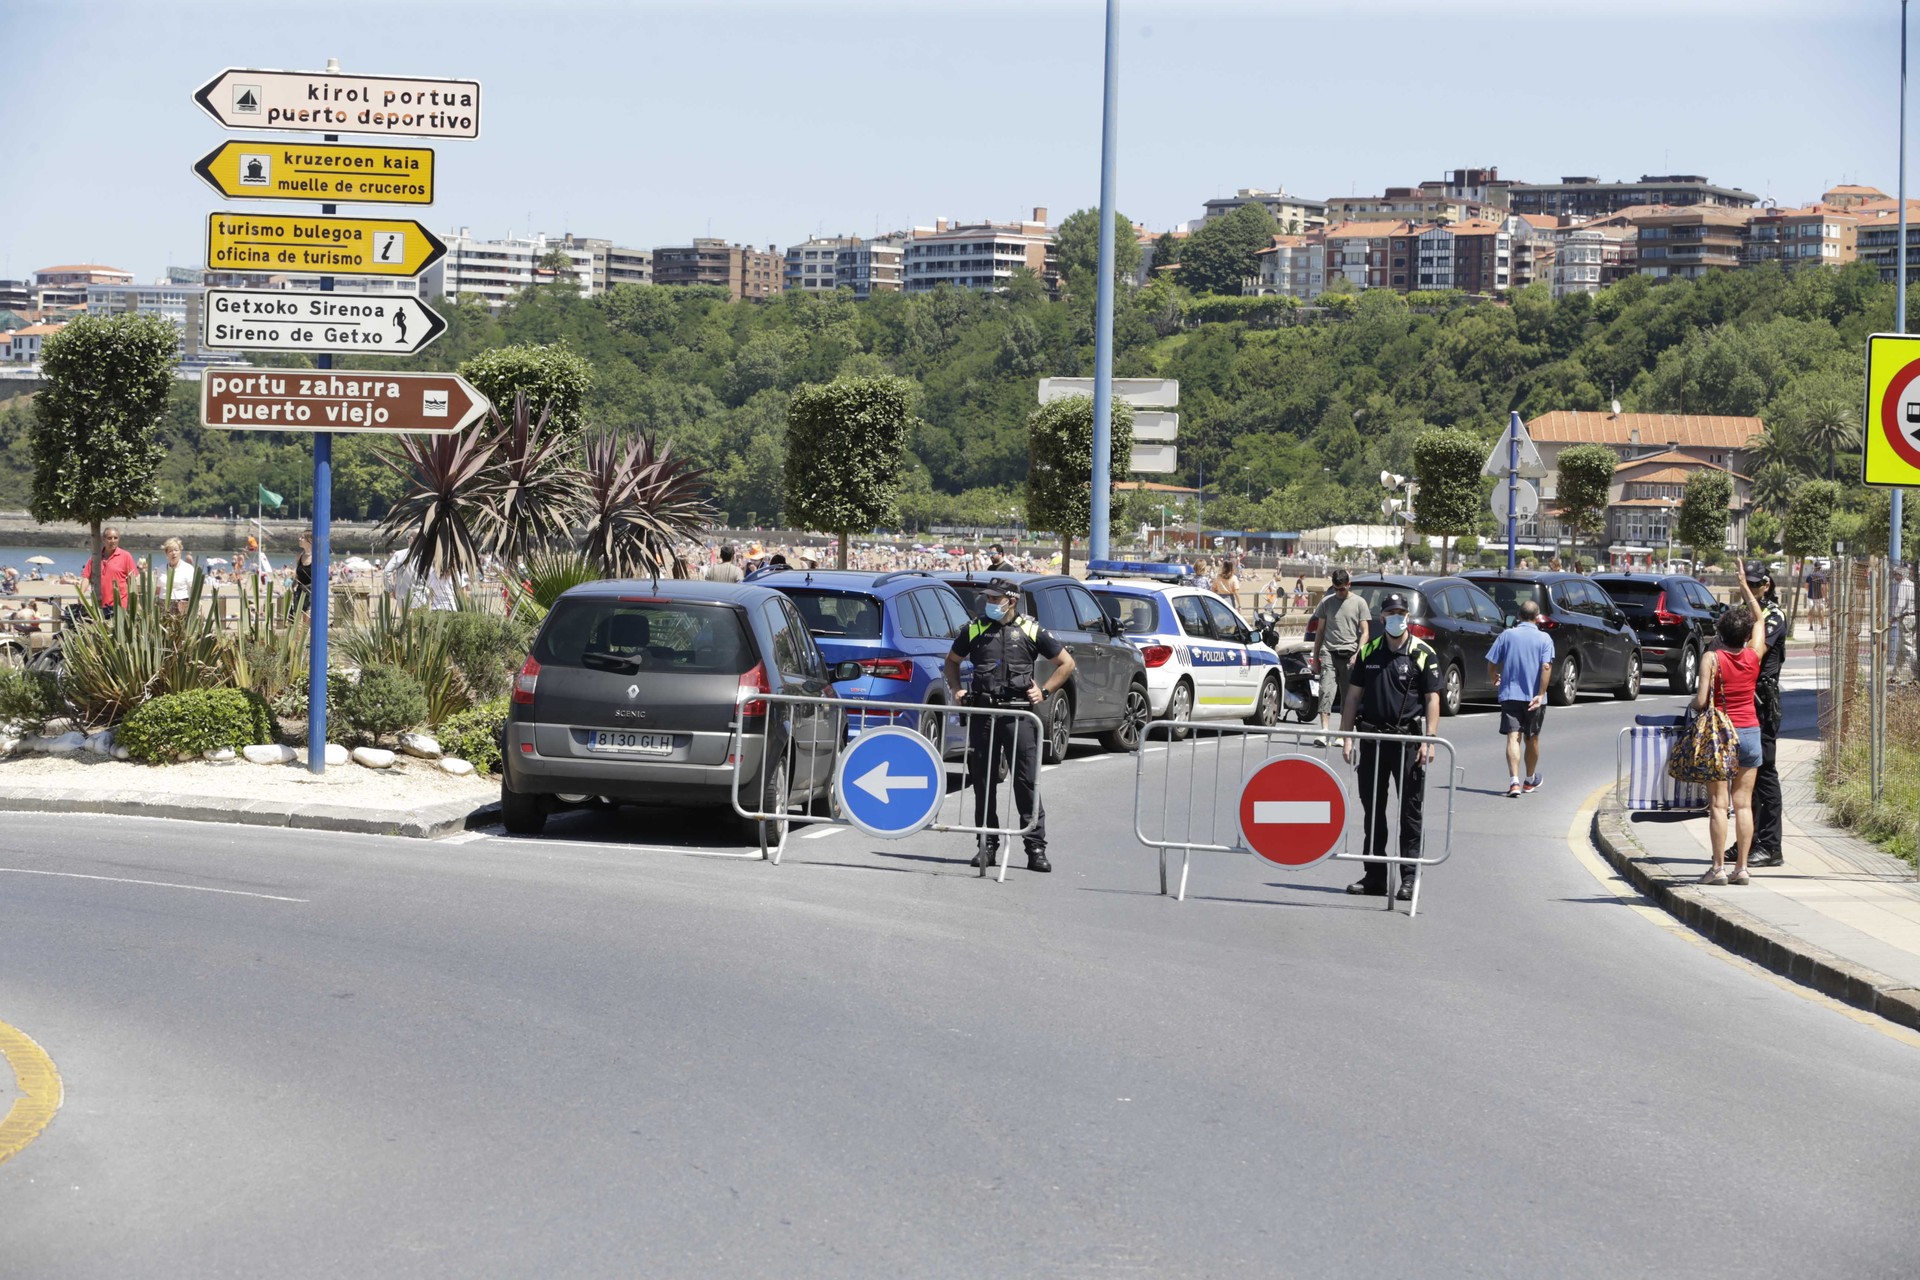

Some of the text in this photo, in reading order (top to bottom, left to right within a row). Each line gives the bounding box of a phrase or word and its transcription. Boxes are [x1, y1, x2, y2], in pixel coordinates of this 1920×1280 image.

[308, 84, 472, 108] kirol portua
[268, 107, 472, 129] puerto deportivo
[284, 151, 419, 170] kruzeroen kaia
[278, 178, 425, 195] muelle de cruceros
[218, 221, 362, 241] turismo bulegoa
[216, 248, 362, 265] oficina de turismo
[215, 297, 384, 317] Getxoko Sirenoa
[215, 324, 383, 344] Sireno de Getxo
[212, 374, 400, 398] portu zaharra
[222, 401, 389, 426] puerto viejo
[1202, 651, 1225, 662] POLIZIA
[615, 709, 646, 718] SCENIC
[598, 733, 670, 750] 8130 GLH
